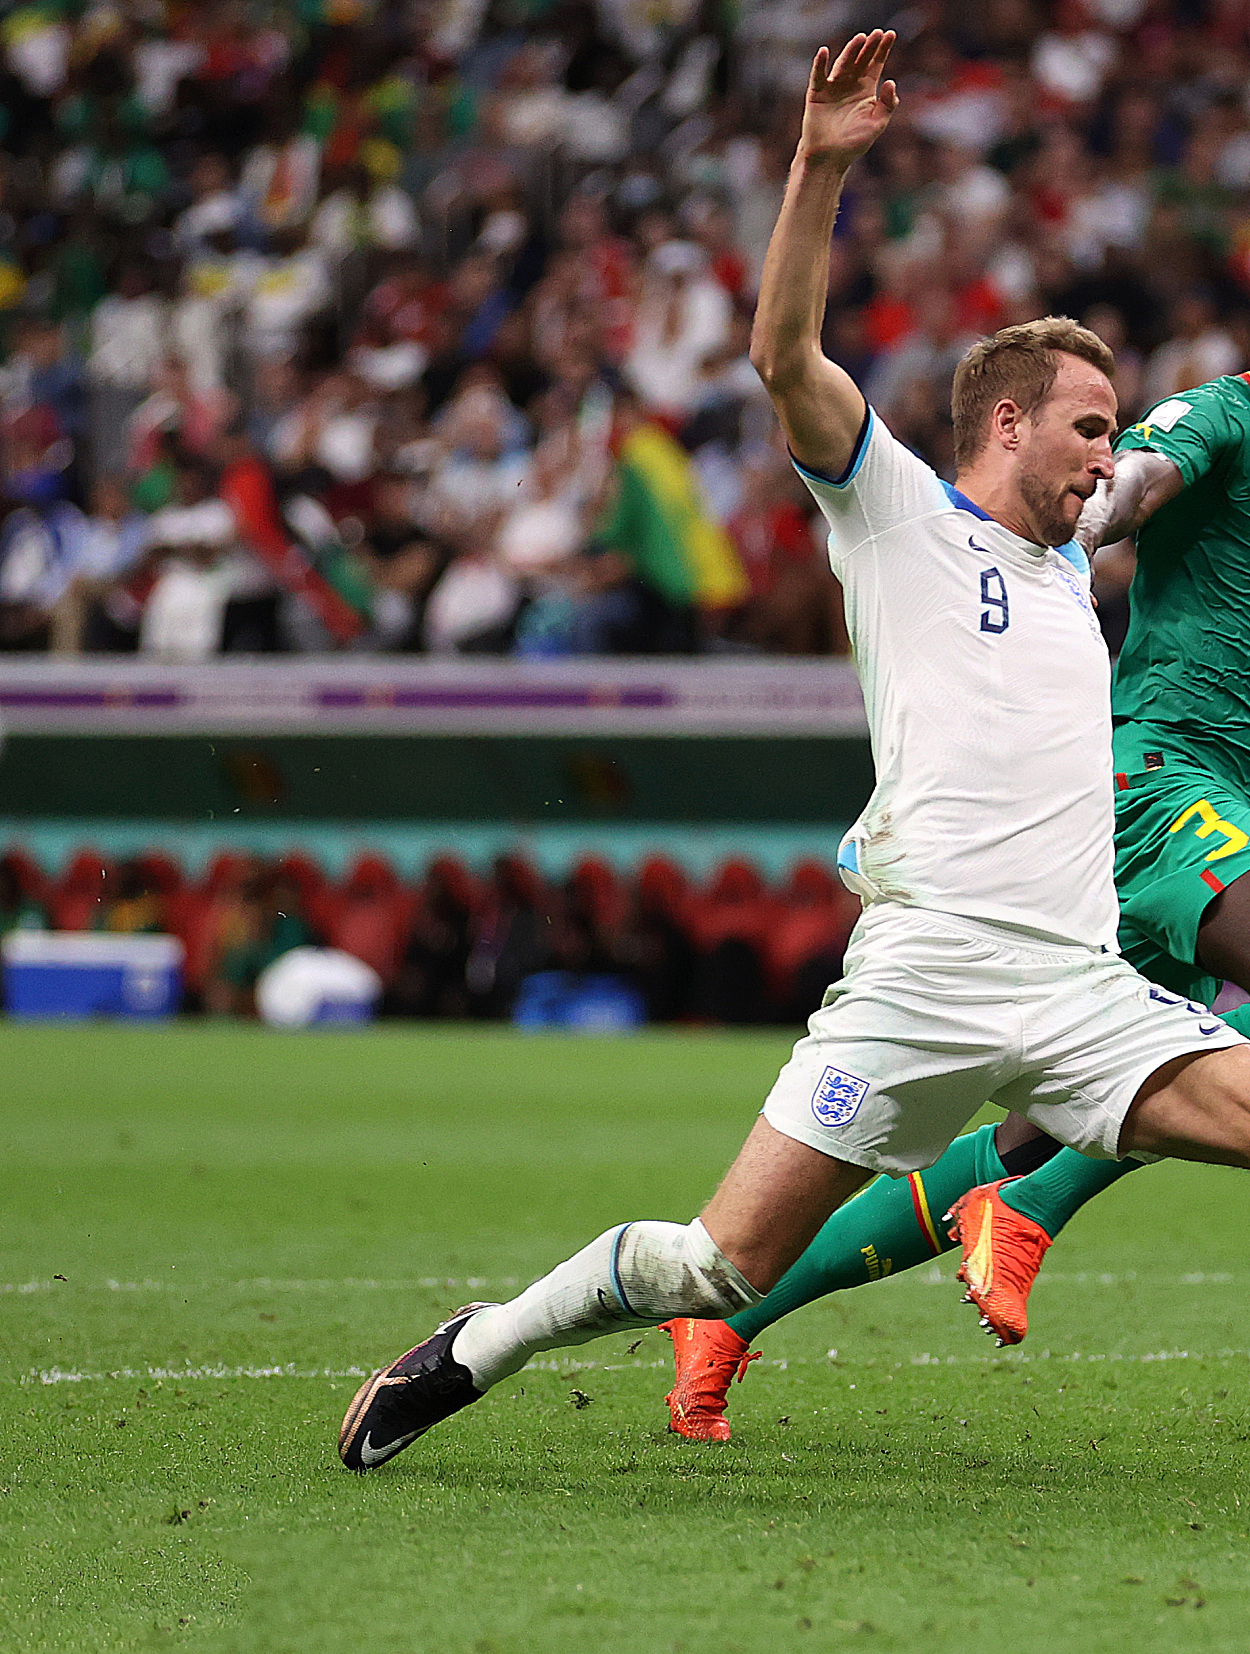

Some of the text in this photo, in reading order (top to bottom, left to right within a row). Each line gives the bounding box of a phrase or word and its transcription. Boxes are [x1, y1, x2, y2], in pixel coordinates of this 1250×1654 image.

[980, 567, 1009, 634] 9
[1169, 799, 1249, 861] 3
[860, 1244, 880, 1281] PUM
